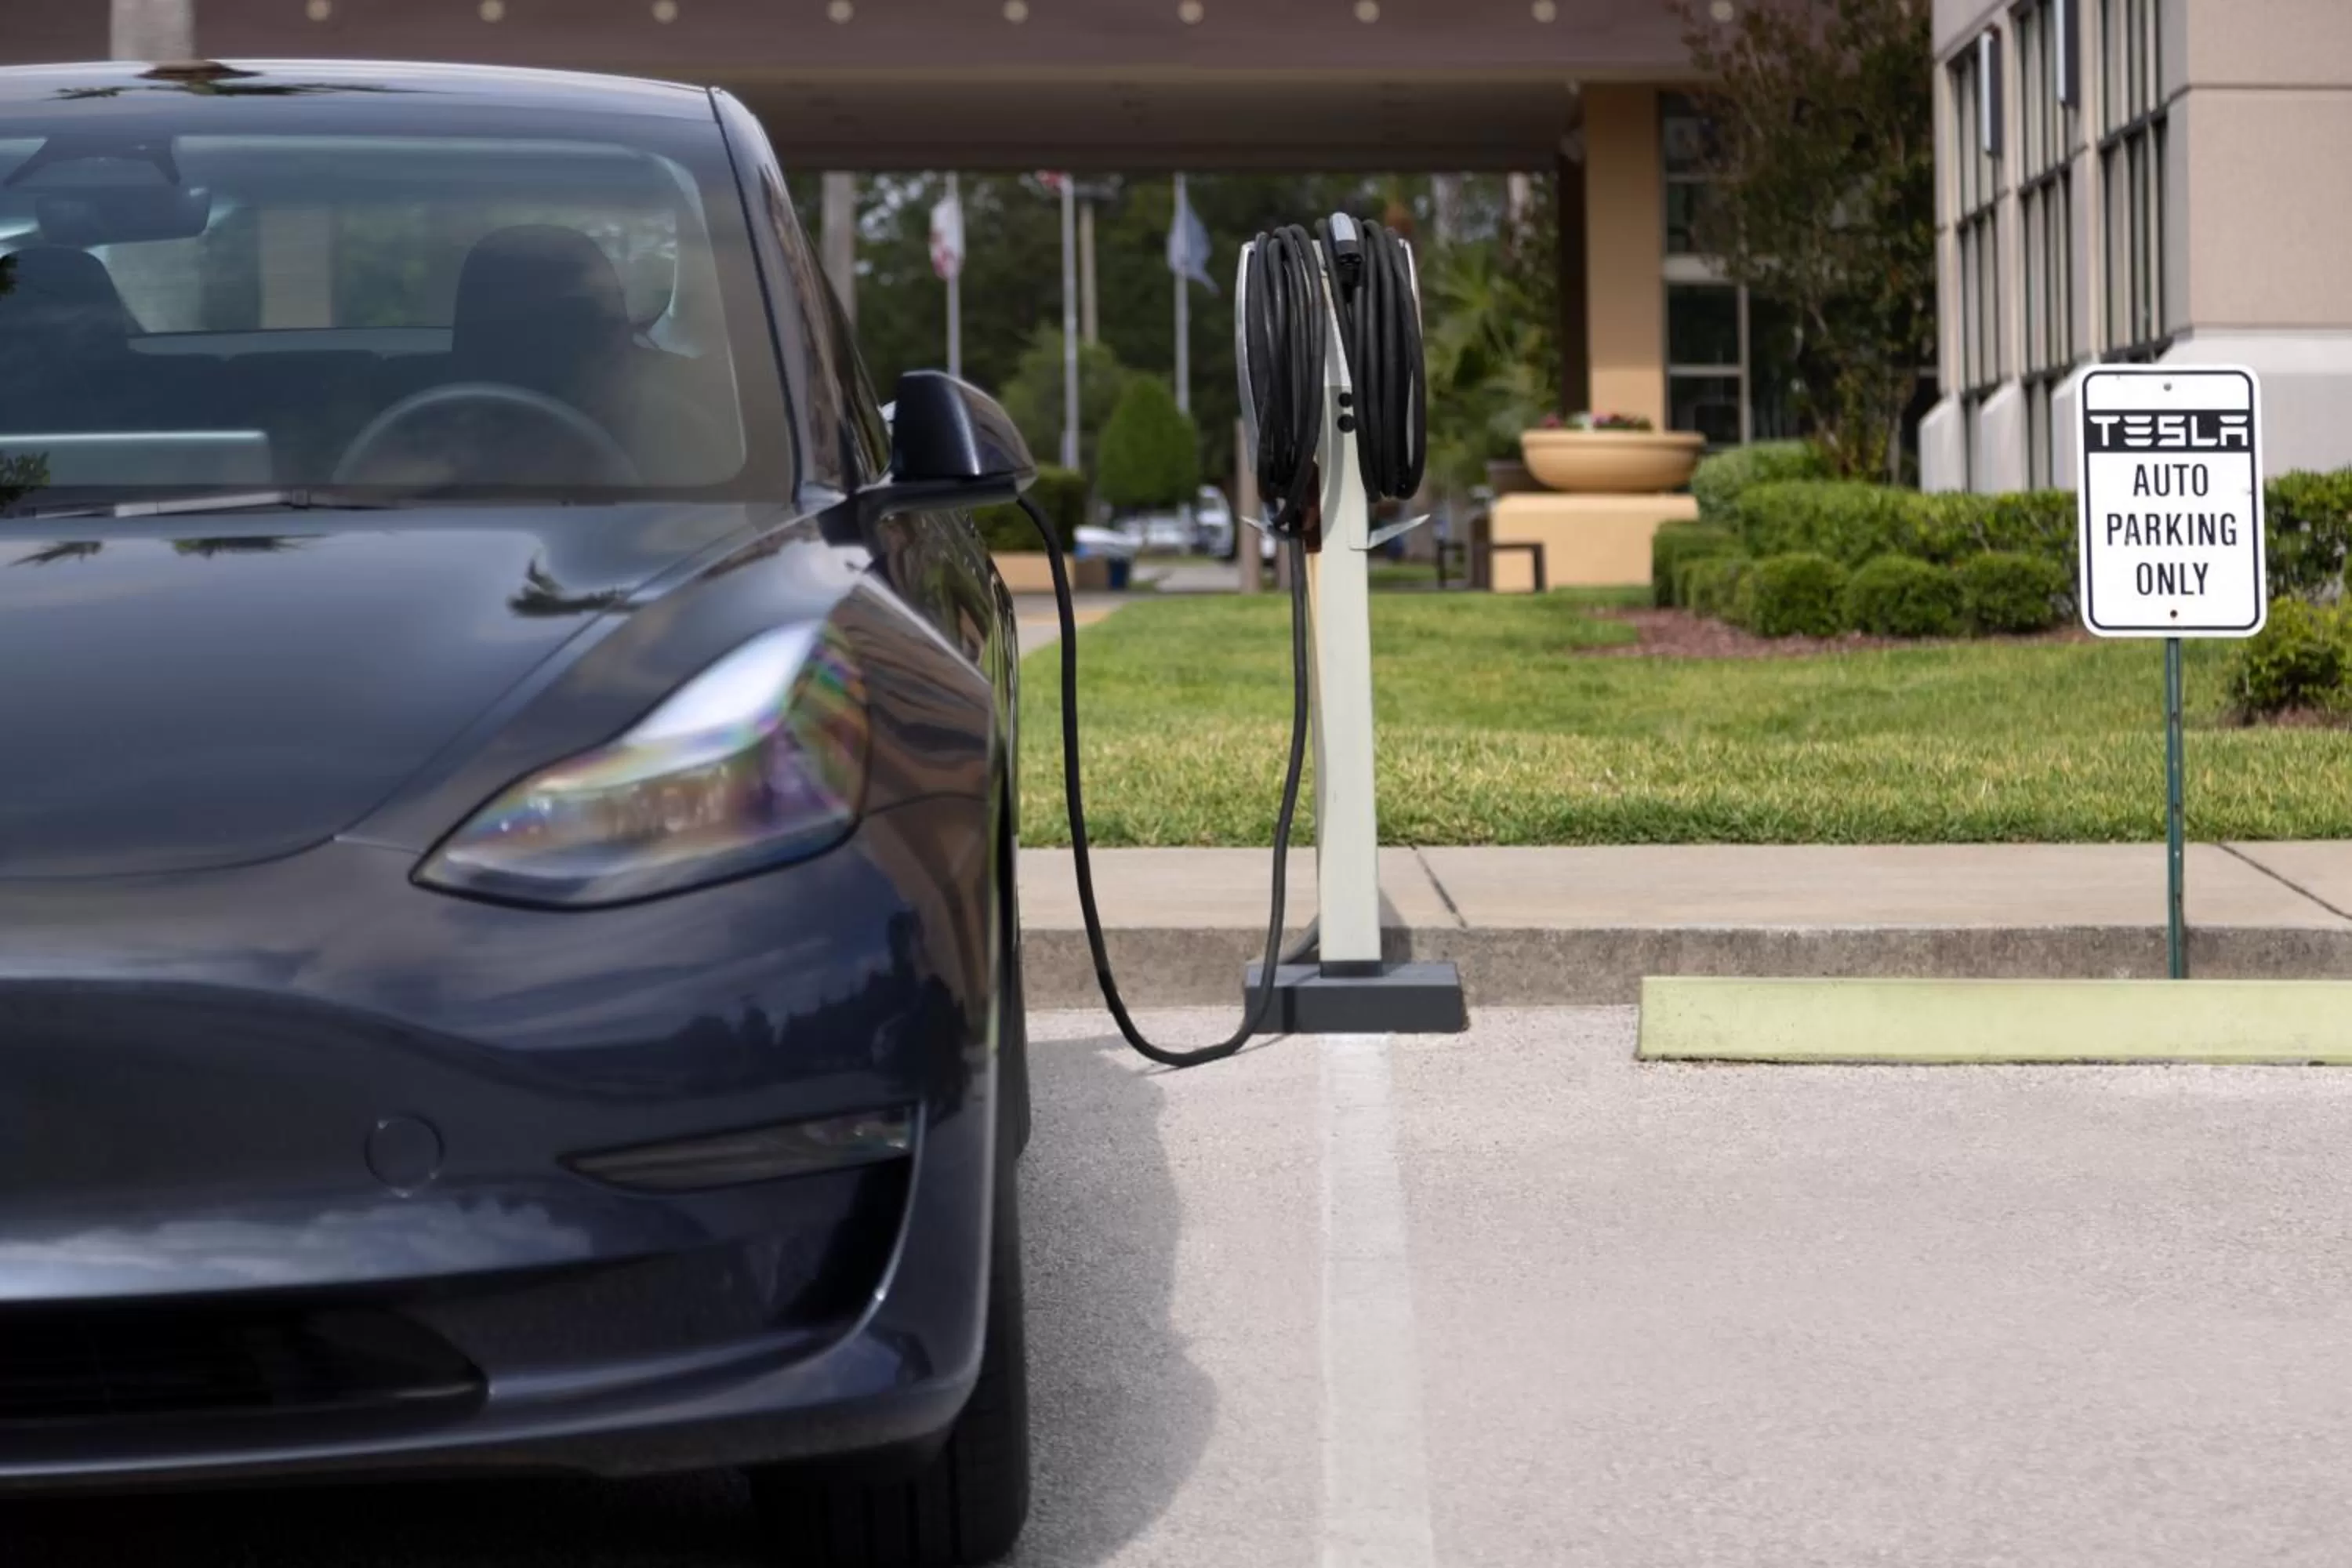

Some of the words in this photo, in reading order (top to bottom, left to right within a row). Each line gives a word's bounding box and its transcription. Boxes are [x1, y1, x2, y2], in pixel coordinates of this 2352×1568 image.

[2089, 415, 2249, 447] TESLA
[2132, 463, 2209, 497] AUTO
[2106, 513, 2237, 546] PARKING
[2136, 561, 2209, 596] ONLY
